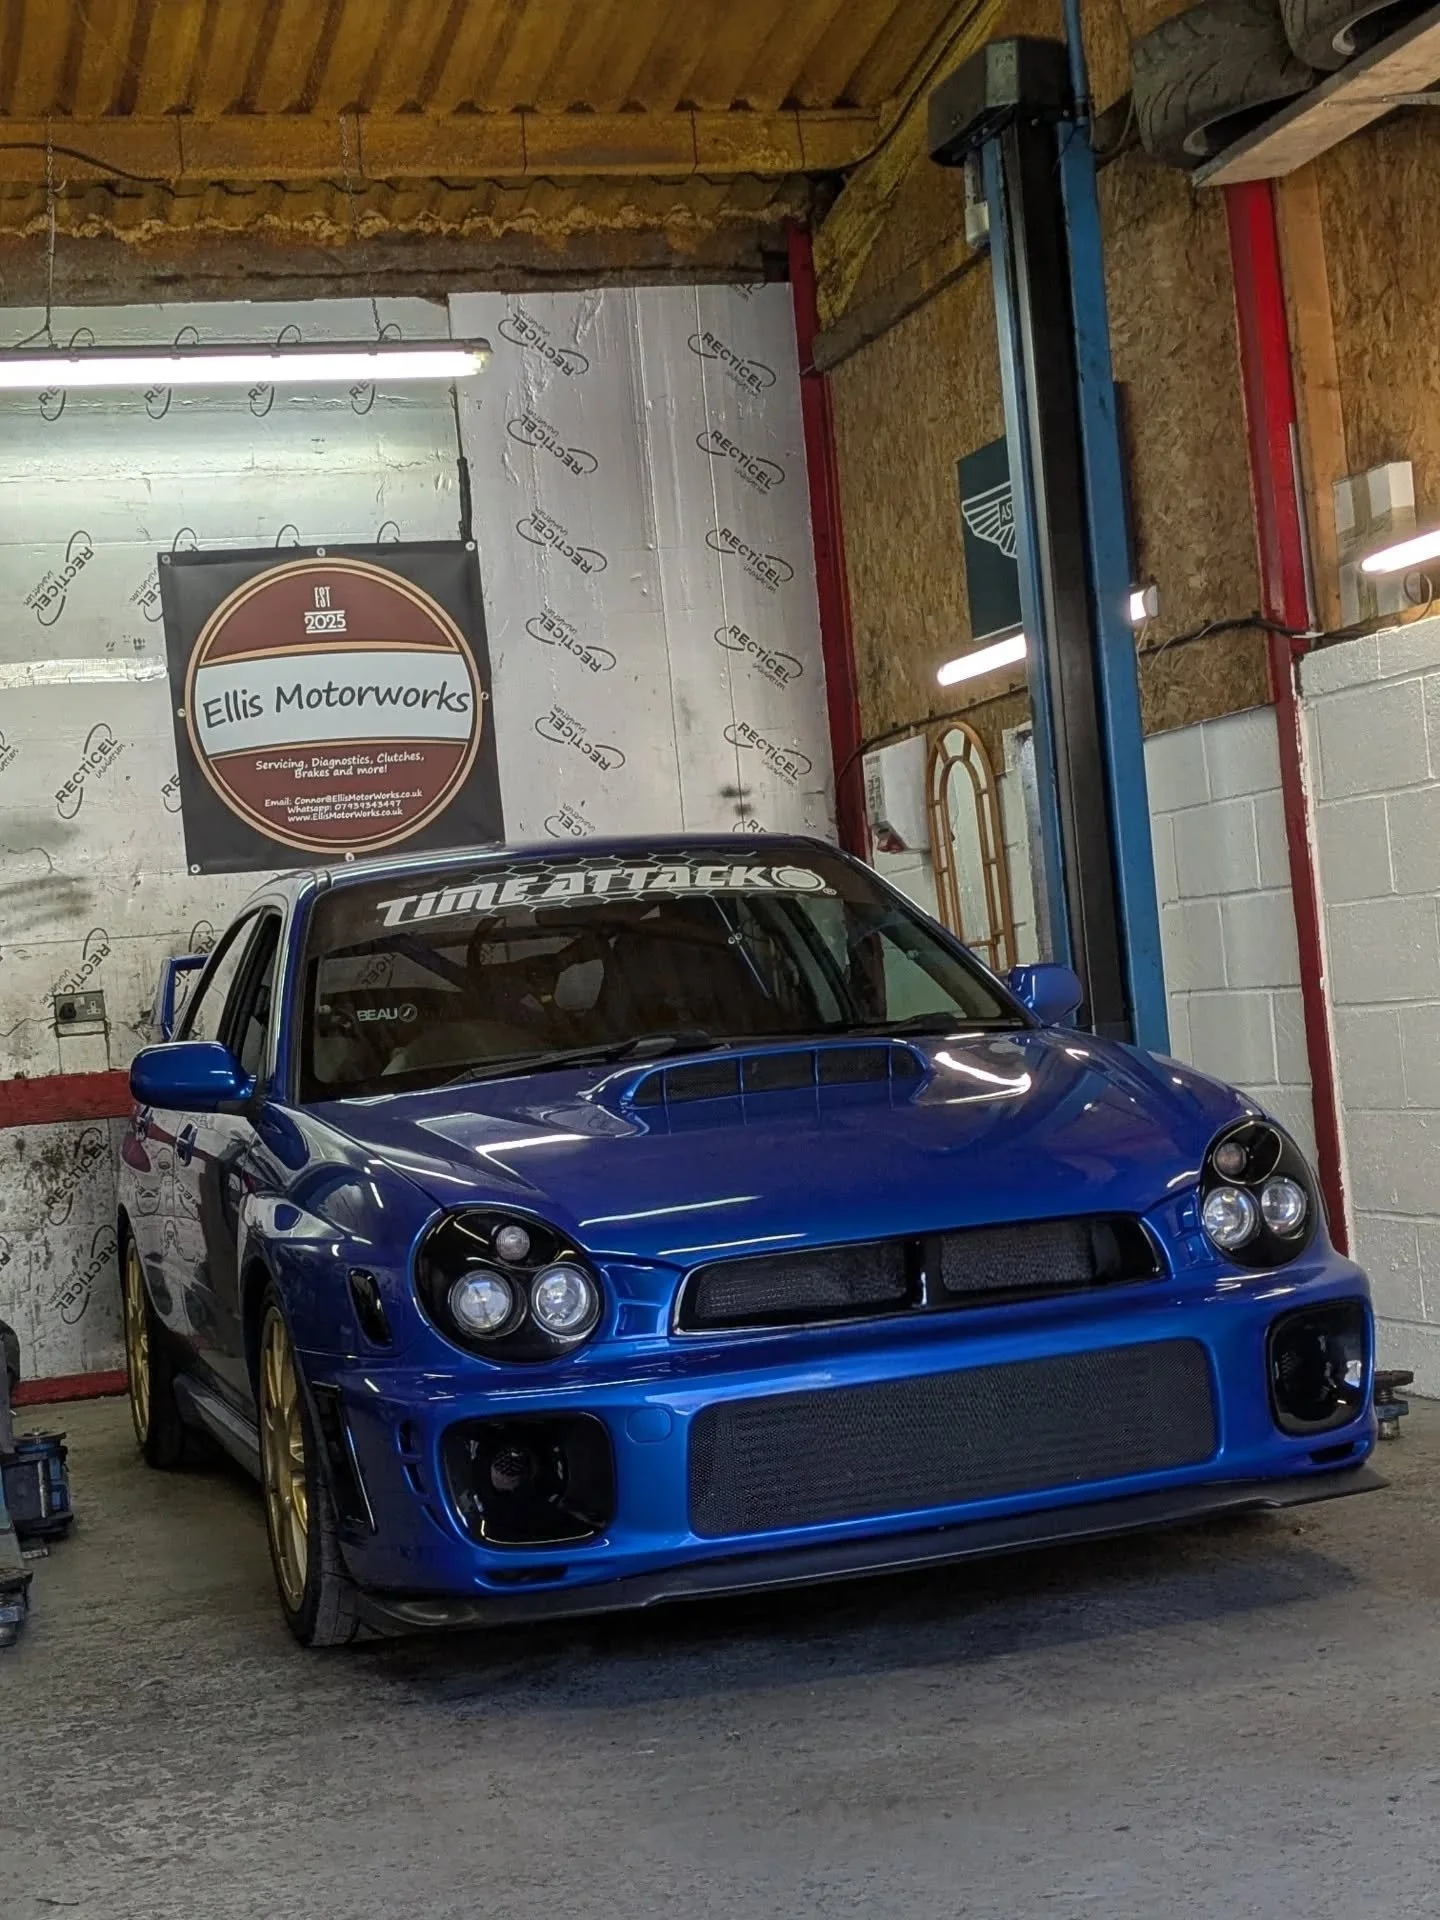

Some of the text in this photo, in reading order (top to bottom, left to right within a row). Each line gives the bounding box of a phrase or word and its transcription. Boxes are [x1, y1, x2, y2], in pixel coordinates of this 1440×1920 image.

[314, 586, 331, 608] EST
[304, 613, 346, 631] 2025
[202, 681, 471, 729] Ellis Motorworks
[255, 751, 425, 771] Servicing, Diagnostics, Clutches,
[294, 764, 388, 779] Brakes and more!
[264, 797, 292, 807] Email:
[357, 1008, 398, 1022] BEAU
